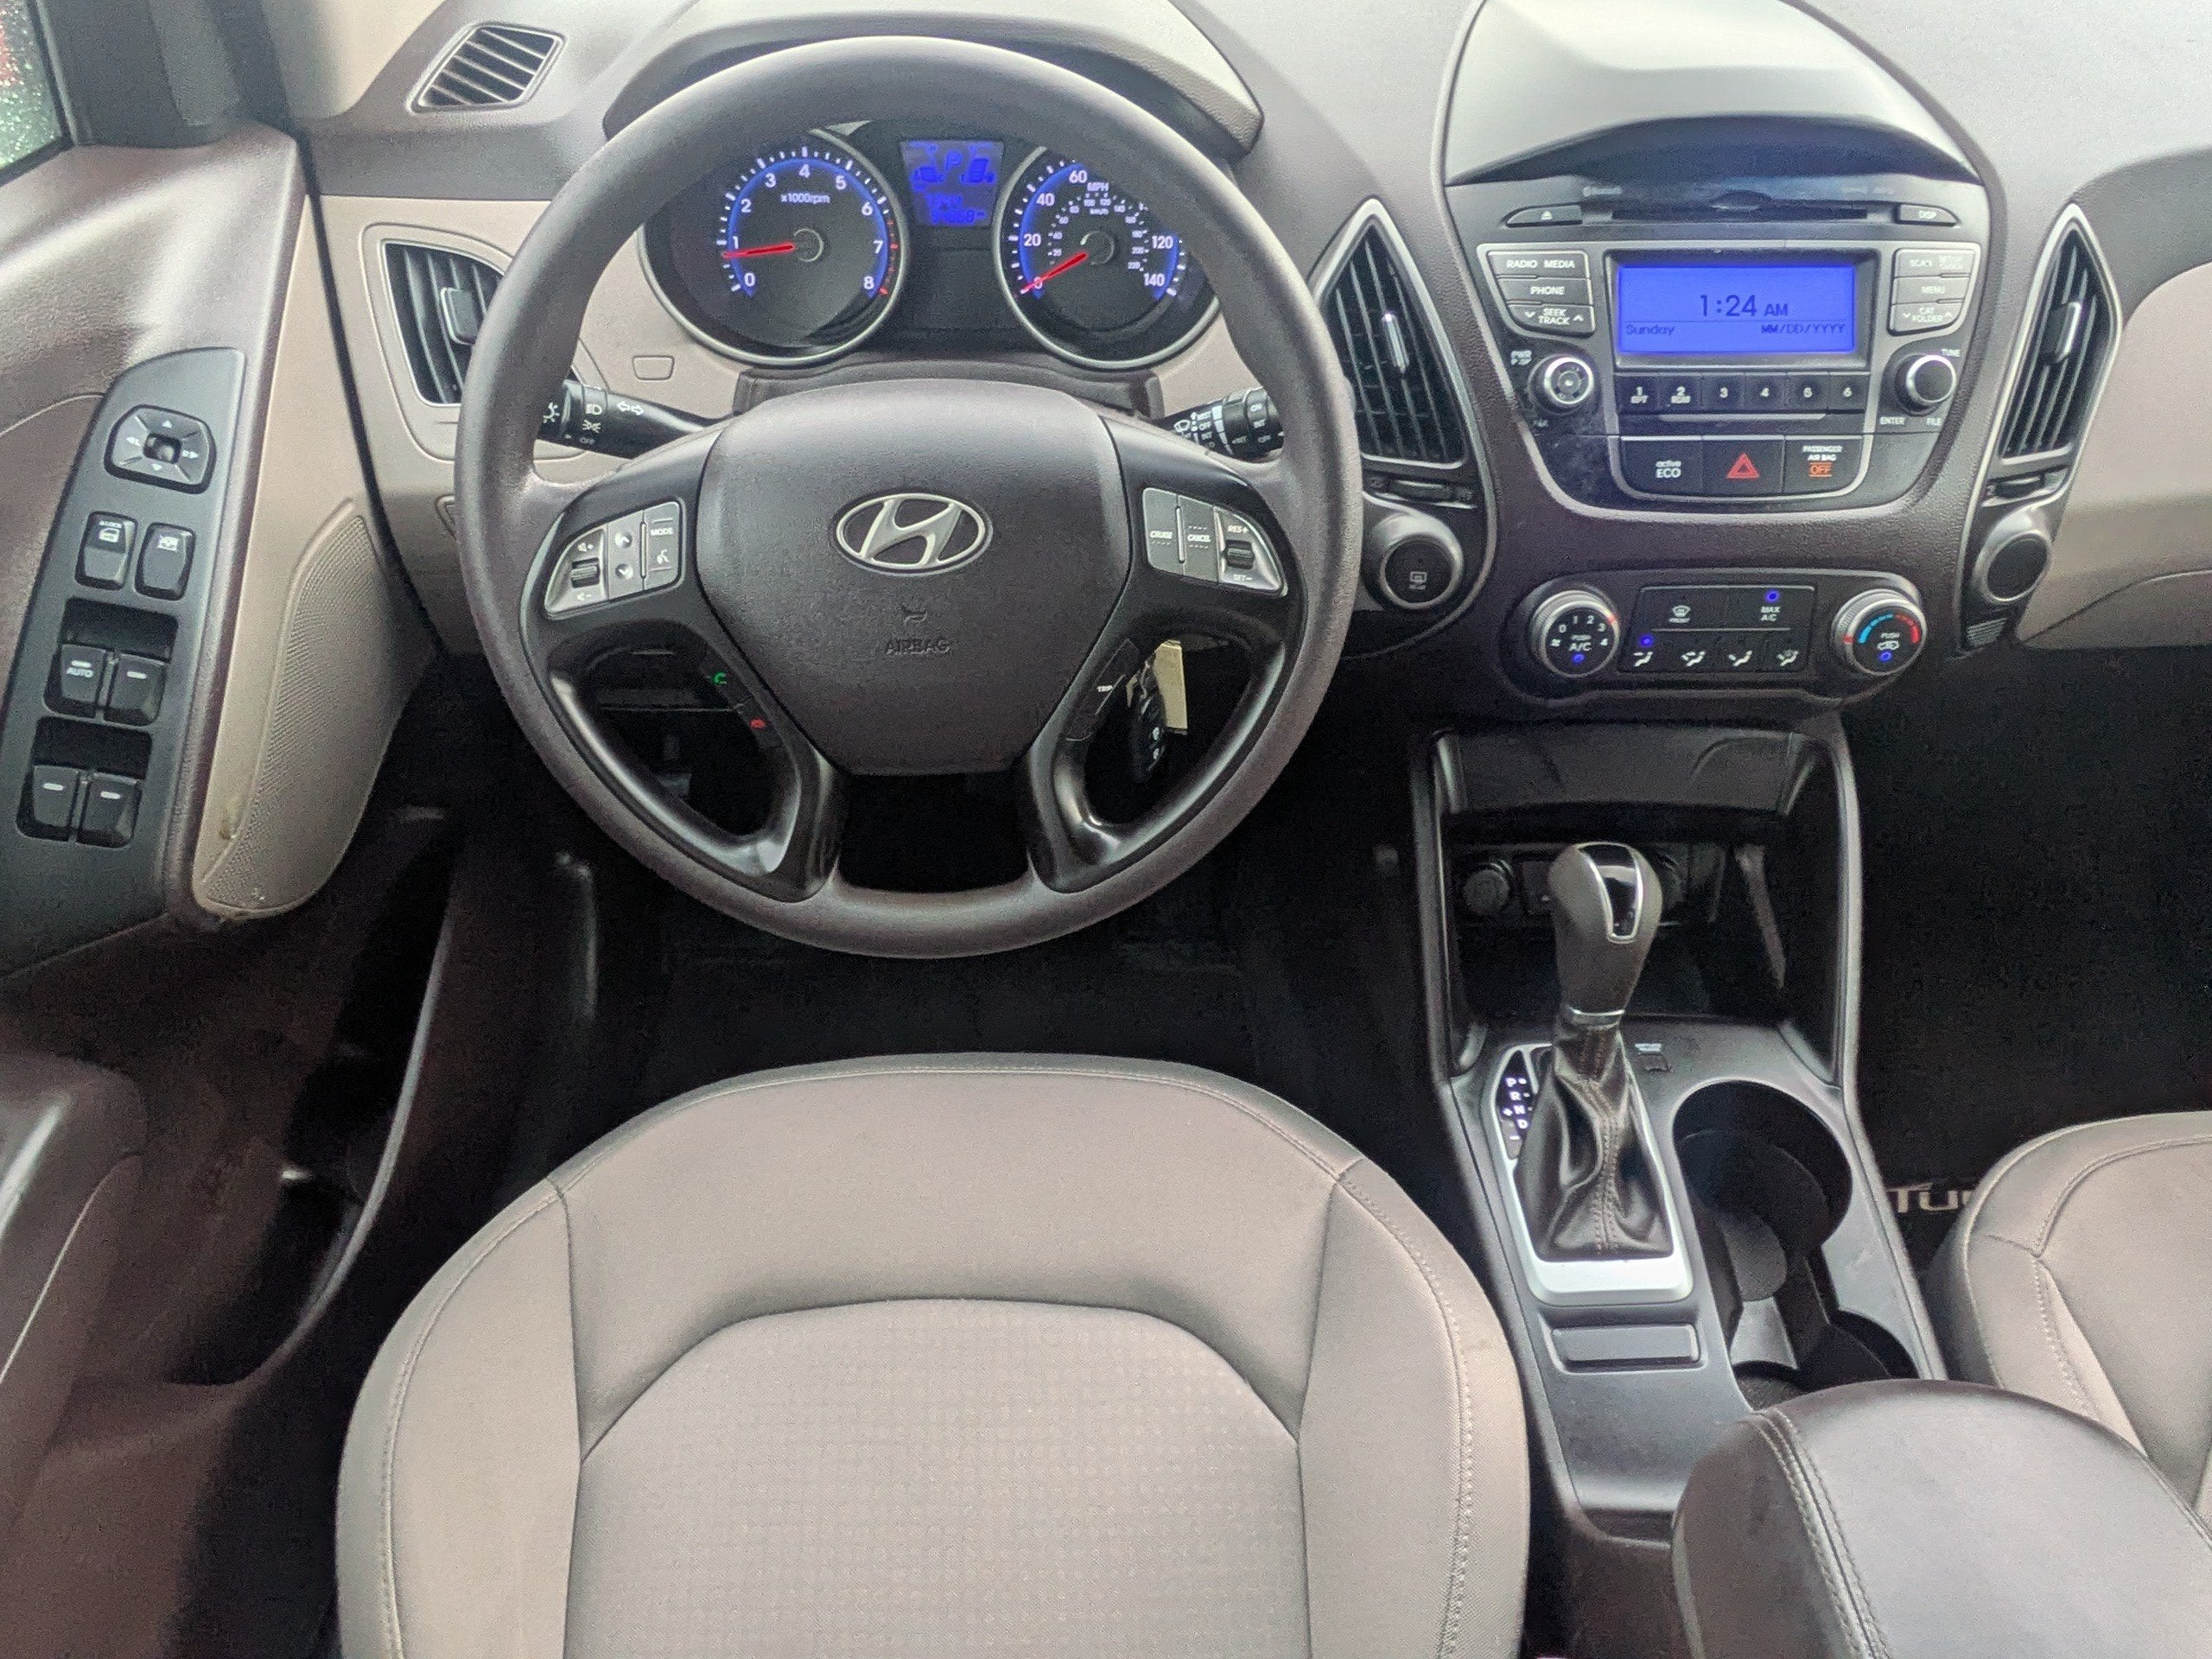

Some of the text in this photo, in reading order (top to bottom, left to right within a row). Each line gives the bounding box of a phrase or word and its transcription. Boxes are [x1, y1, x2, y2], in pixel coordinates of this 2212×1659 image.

[798, 164, 810, 178] 4
[1069, 170, 1088, 183] 60
[765, 174, 777, 188] 3
[836, 175, 847, 189] 5
[1087, 182, 1109, 191] MPH
[1037, 193, 1055, 207] 40
[741, 200, 752, 213] 2
[862, 203, 873, 216] 6
[732, 237, 740, 248] 1
[1024, 233, 1042, 247] 20
[1152, 235, 1173, 249] 120
[874, 240, 884, 253] 7
[1507, 259, 1575, 269] RADIO MEDIA
[744, 273, 756, 286] 0
[864, 276, 874, 289] 8
[1143, 273, 1165, 286] 140
[1530, 286, 1565, 295] PHONE
[1700, 295, 1789, 316] 1:24 AM
[1538, 316, 1570, 325] TRACK
[1625, 324, 1675, 336] Sunday
[1761, 323, 1846, 334] MM/DD/YYYY
[1636, 386, 1643, 396] 1
[1676, 386, 1686, 396] 2
[1720, 387, 1728, 397] 3
[1656, 467, 1681, 479] ECO
[1810, 465, 1831, 474] OFF
[650, 527, 674, 536] MODE
[1573, 615, 1579, 624] 1
[1586, 615, 1595, 624] 2
[67, 667, 93, 678] AUTO
[1505, 1077, 1516, 1088] P
[1510, 1092, 1521, 1101] R
[1514, 1105, 1526, 1115] N
